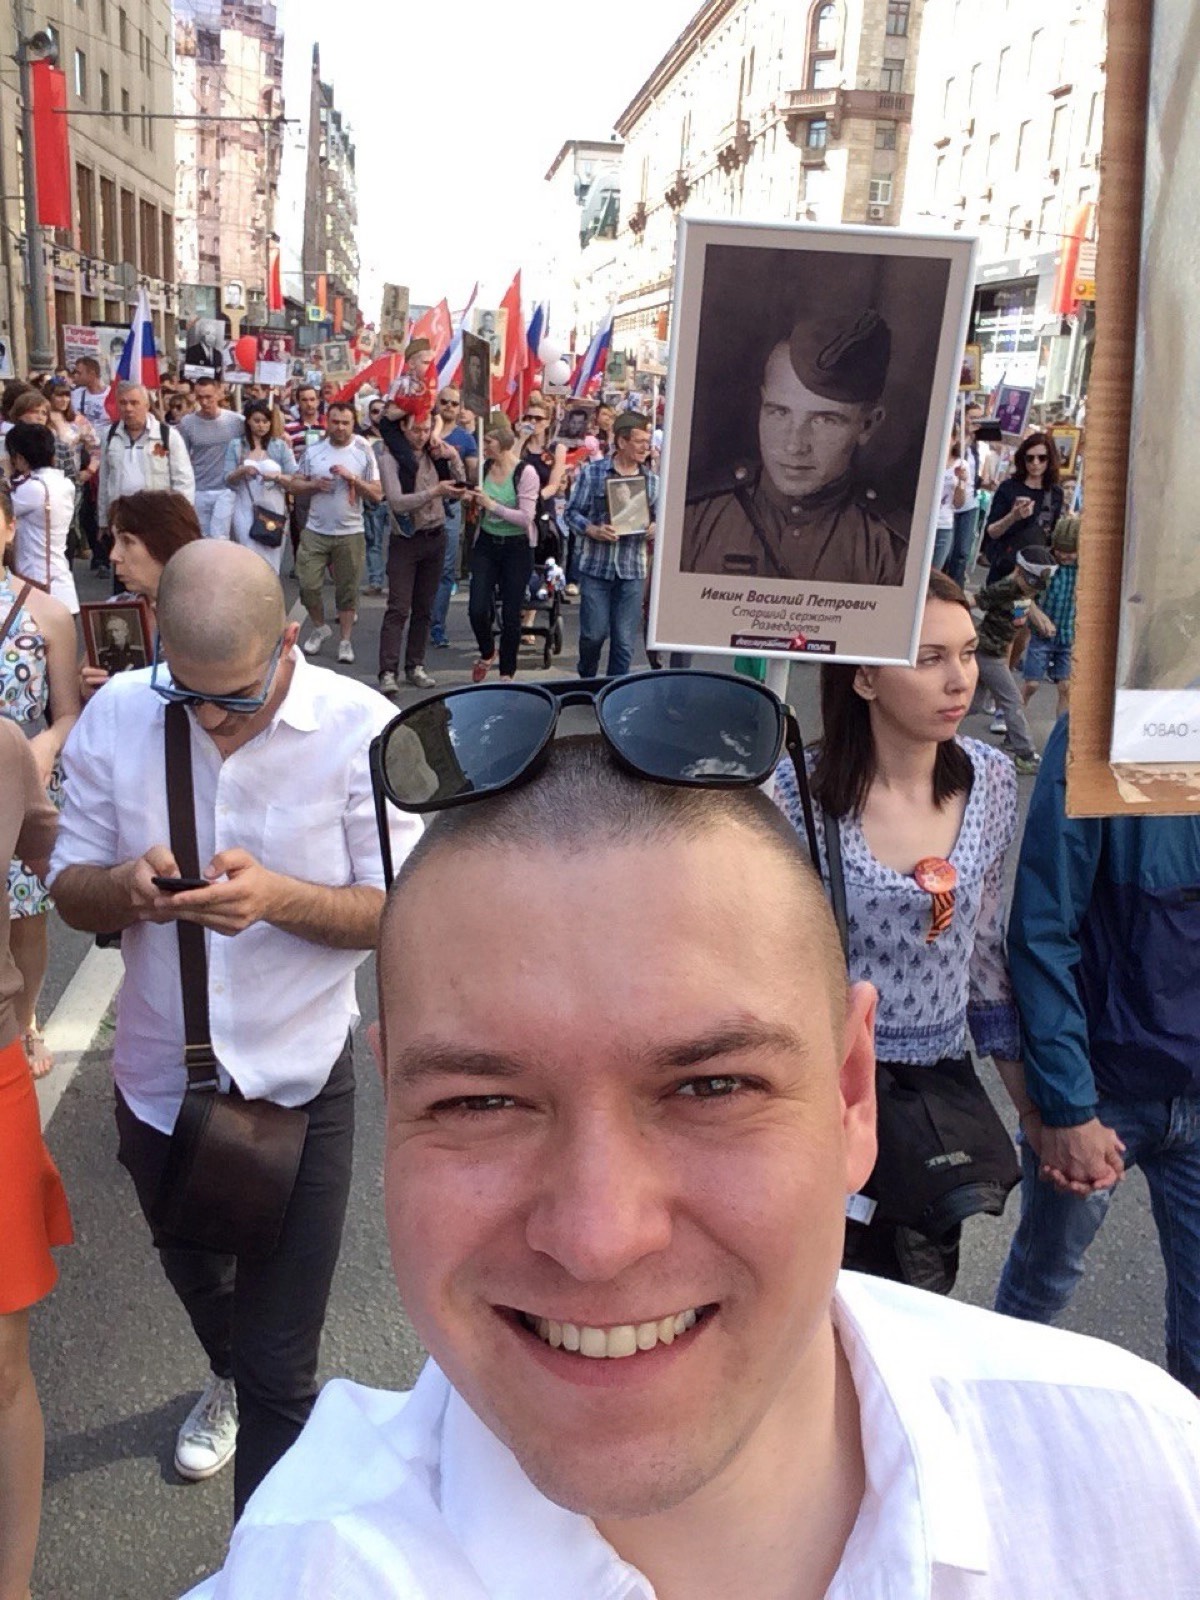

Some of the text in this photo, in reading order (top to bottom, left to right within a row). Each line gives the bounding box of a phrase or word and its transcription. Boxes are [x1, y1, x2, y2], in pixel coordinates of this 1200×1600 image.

[746, 590, 804, 606] Василий
[806, 594, 877, 611] Петрович
[731, 606, 842, 624] Старший сержант
[751, 619, 820, 634] Разведрота
[1142, 723, 1189, 737] ЮВАО
